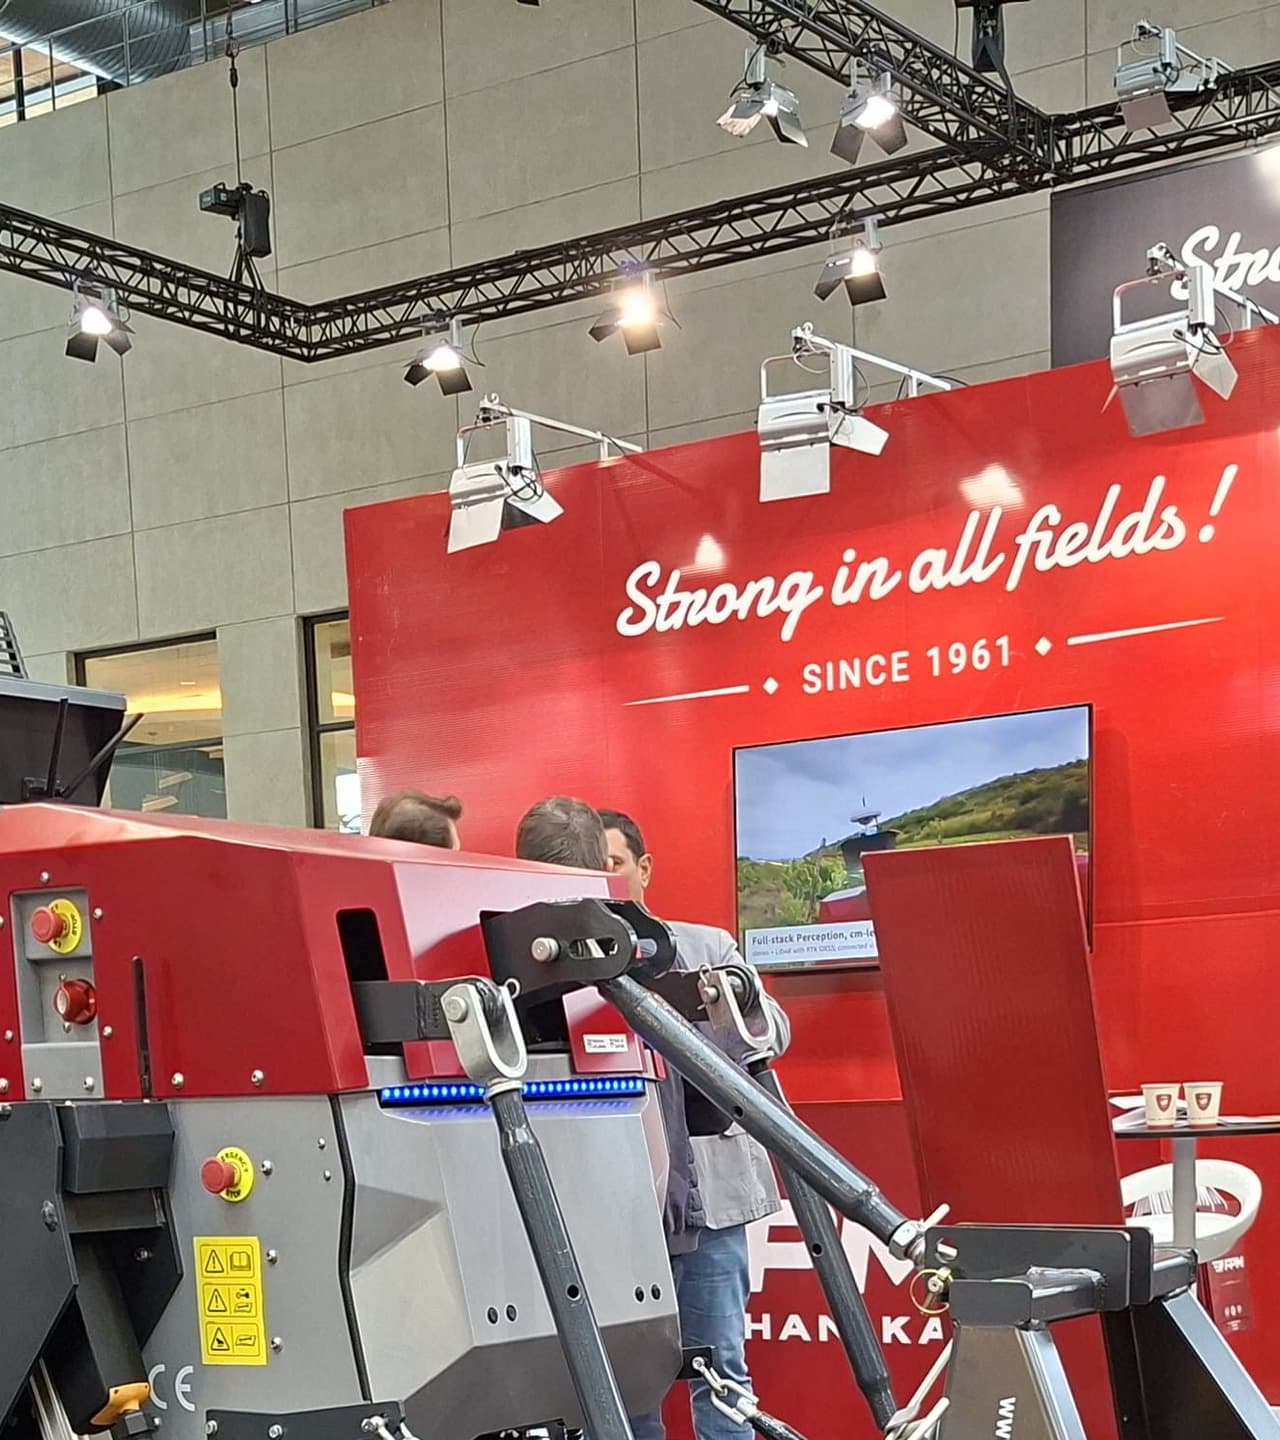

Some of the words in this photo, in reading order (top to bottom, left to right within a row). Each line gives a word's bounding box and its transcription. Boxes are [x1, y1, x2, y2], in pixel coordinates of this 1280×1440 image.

[615, 560, 824, 641] Strong
[831, 547, 904, 605] in
[907, 504, 1008, 593] all
[801, 651, 910, 696] SINCE
[927, 635, 1013, 679] 1961
[752, 935, 794, 946] Full-stack
[796, 929, 848, 942] Perception,
